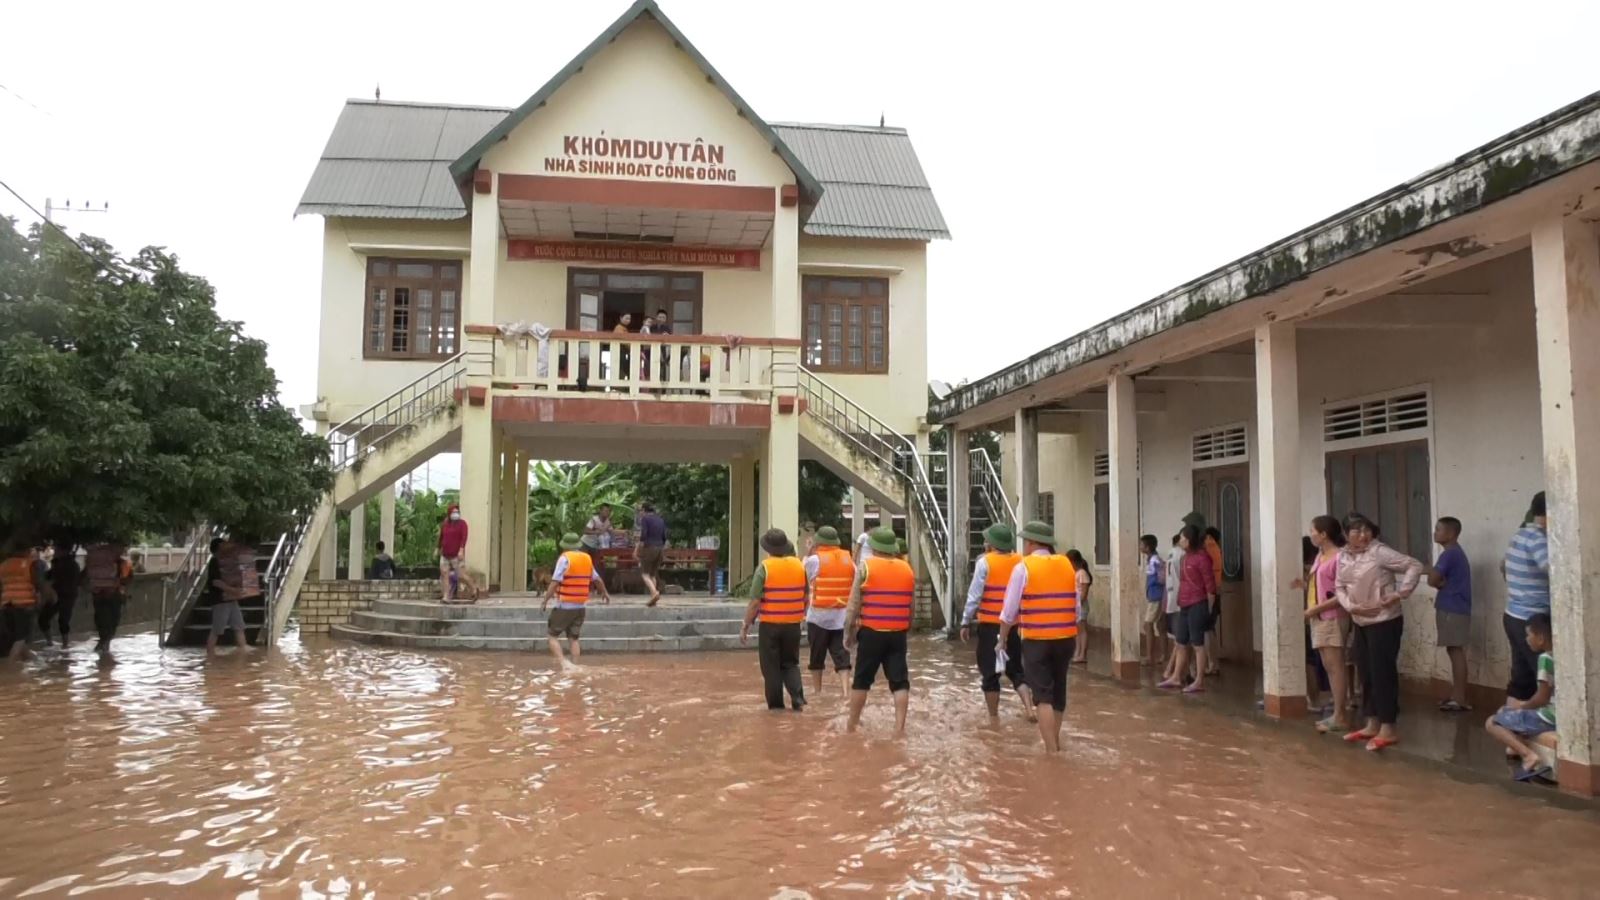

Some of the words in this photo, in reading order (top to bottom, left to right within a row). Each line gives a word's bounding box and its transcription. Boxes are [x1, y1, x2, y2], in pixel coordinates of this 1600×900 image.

[633, 140, 678, 161] DUY
[679, 137, 724, 164] TÂN
[544, 154, 576, 172] NHÀ
[578, 160, 615, 175] SINH
